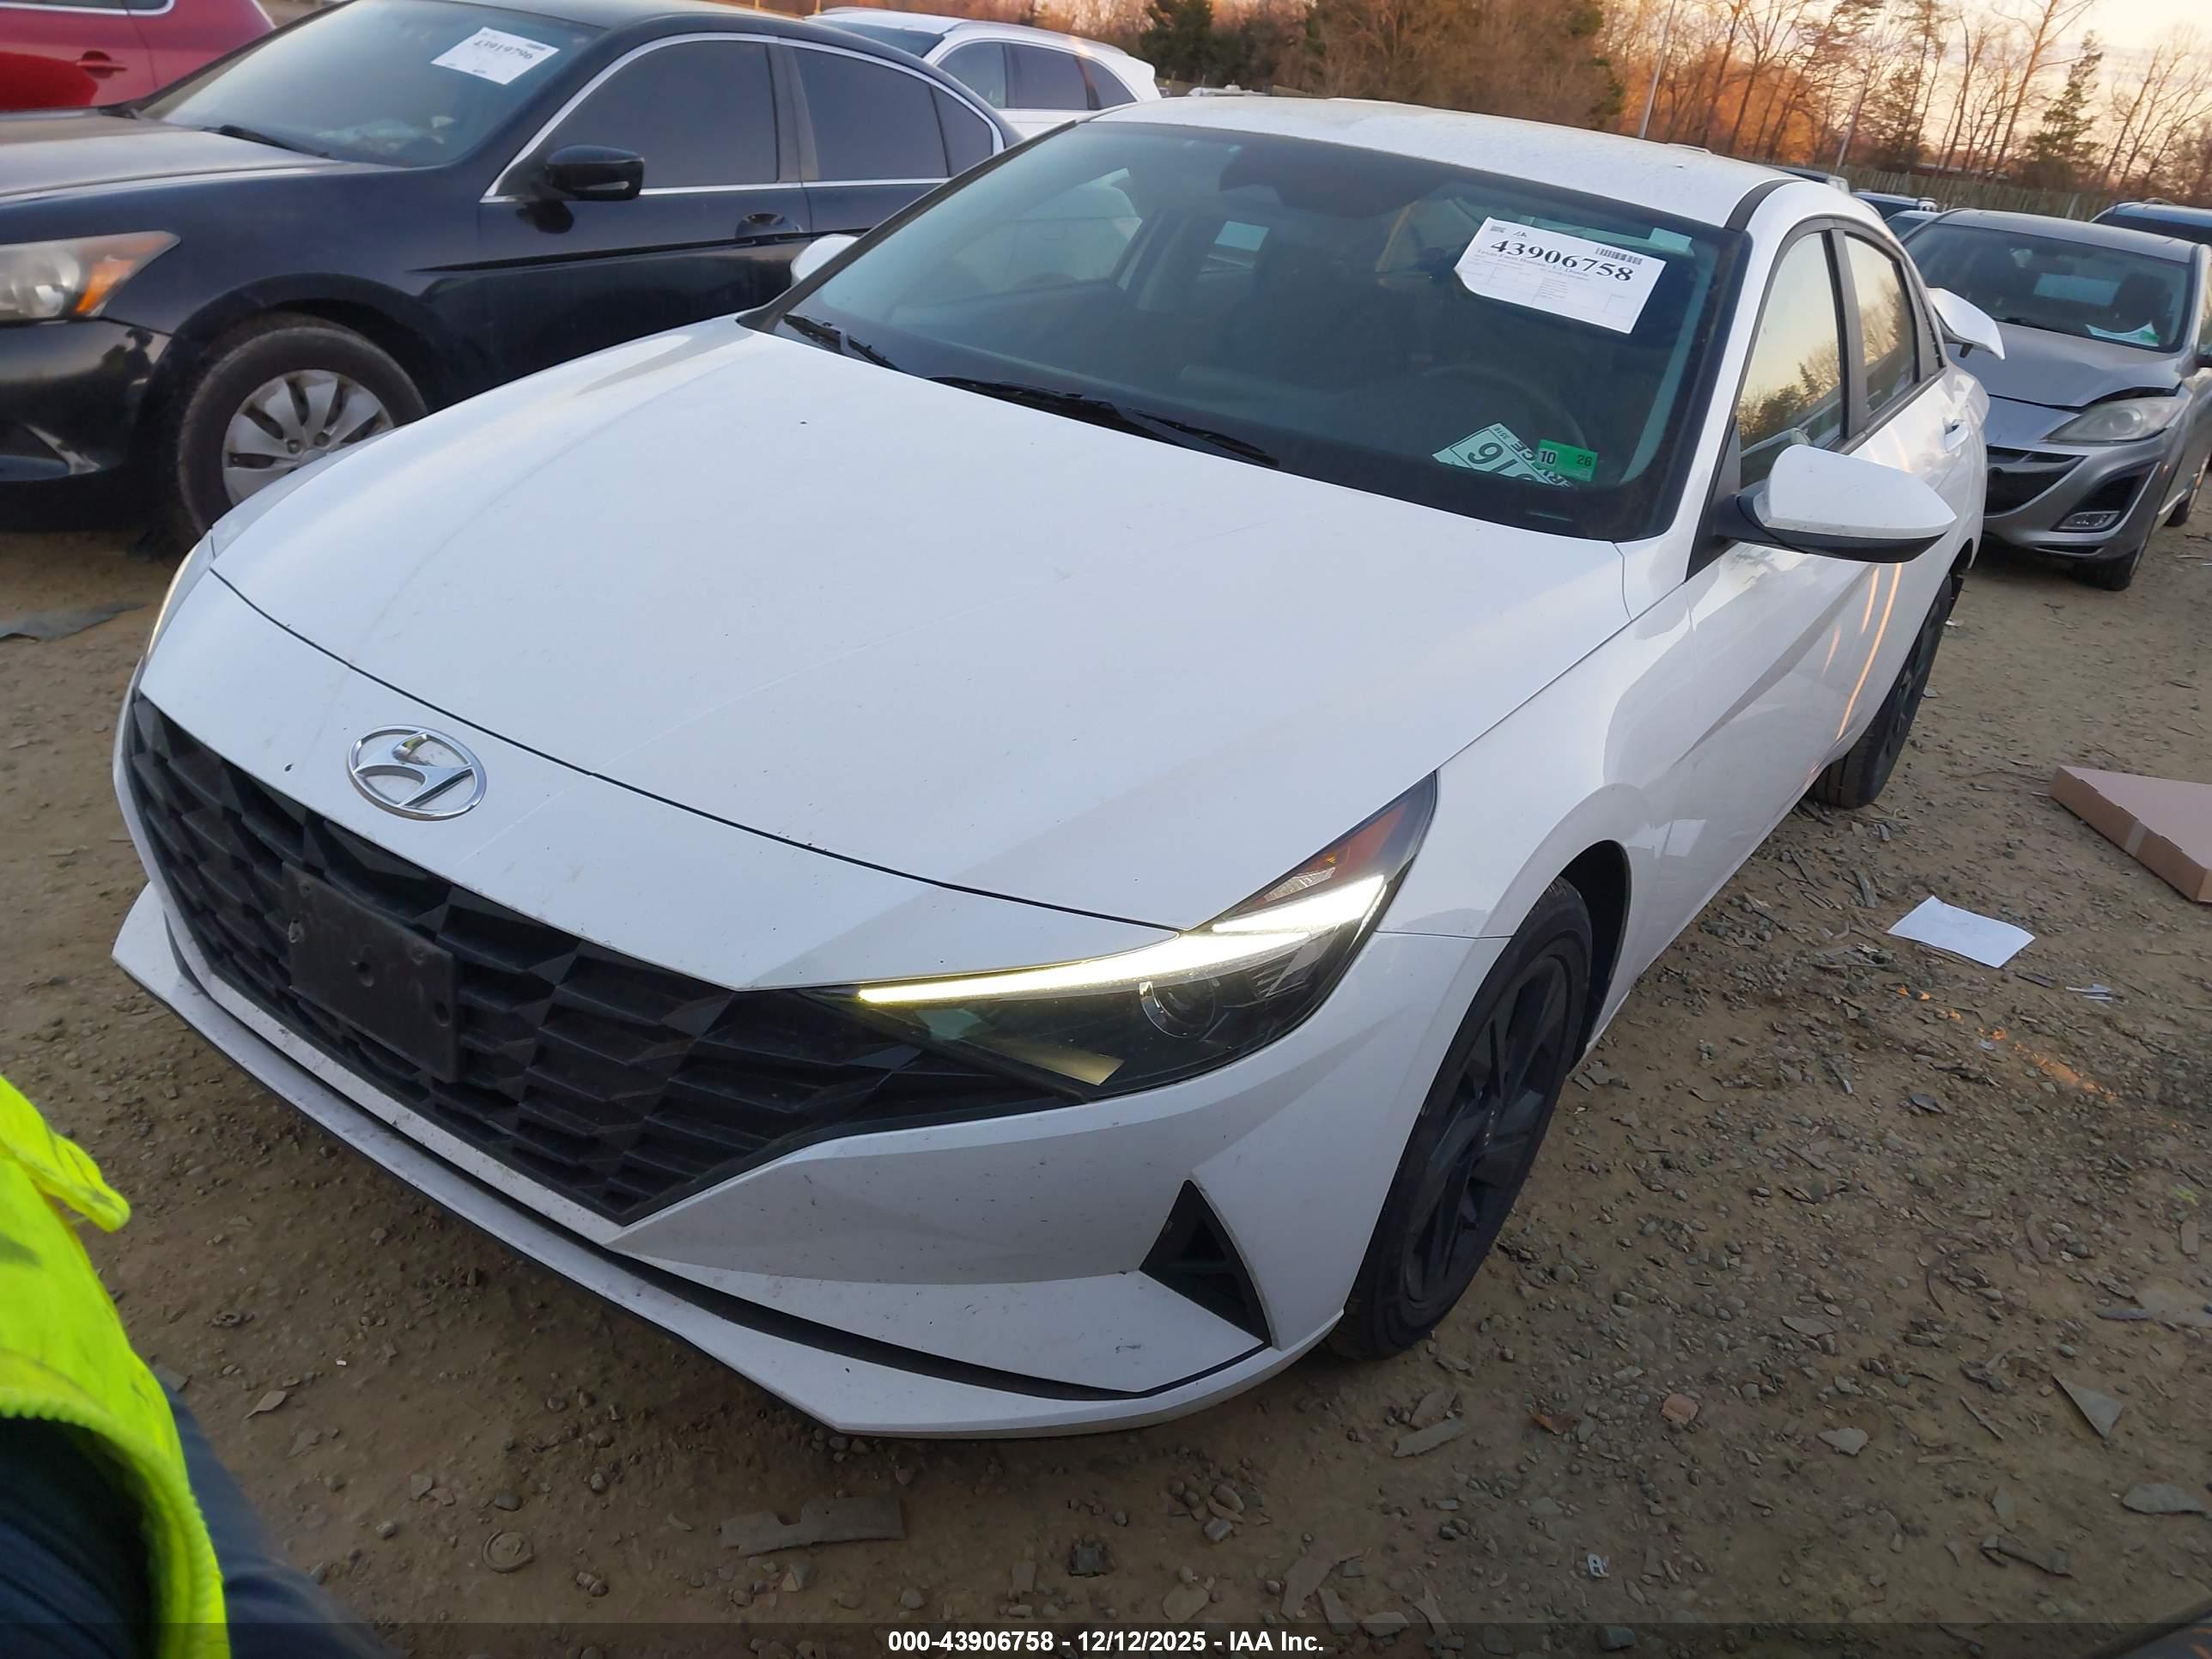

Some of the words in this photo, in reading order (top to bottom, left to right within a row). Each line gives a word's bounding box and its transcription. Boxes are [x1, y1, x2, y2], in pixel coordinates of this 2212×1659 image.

[1491, 240, 1634, 282] 43906758
[1540, 451, 1557, 465] 10
[1577, 453, 1593, 466] 26
